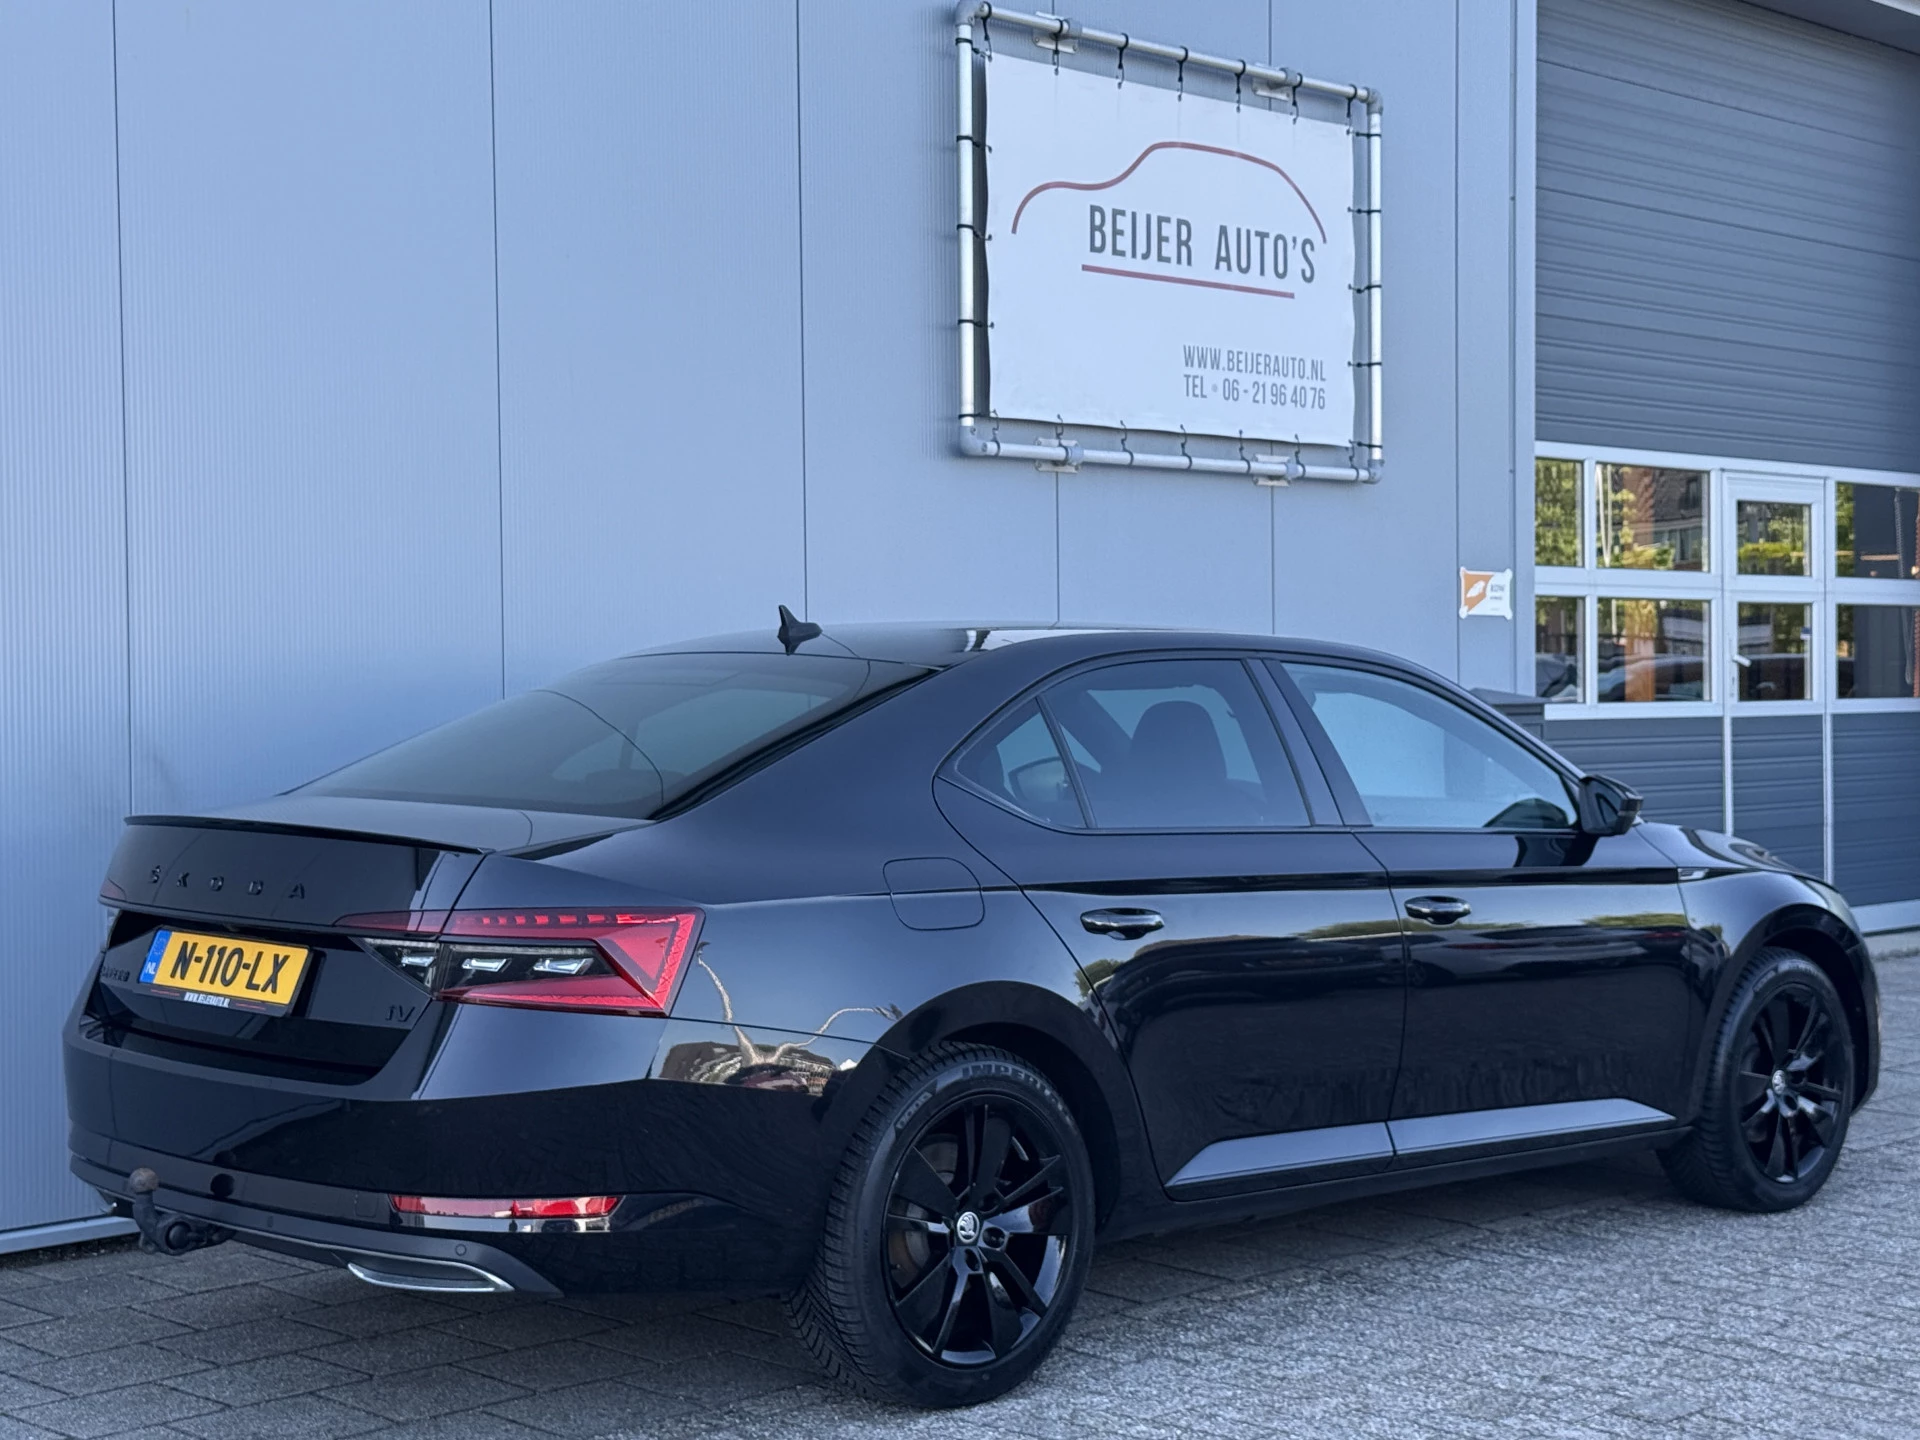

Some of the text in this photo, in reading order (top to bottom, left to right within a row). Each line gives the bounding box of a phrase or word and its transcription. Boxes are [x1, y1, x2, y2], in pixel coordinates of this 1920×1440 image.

[1089, 204, 1316, 284] BEIJER AUTO'S
[1183, 344, 1326, 382] WWW.BEIJERAUTO.NL
[1183, 374, 1208, 399] TEL
[1222, 378, 1240, 402] 06
[145, 961, 156, 975] NL
[170, 940, 291, 994] N-110-LX
